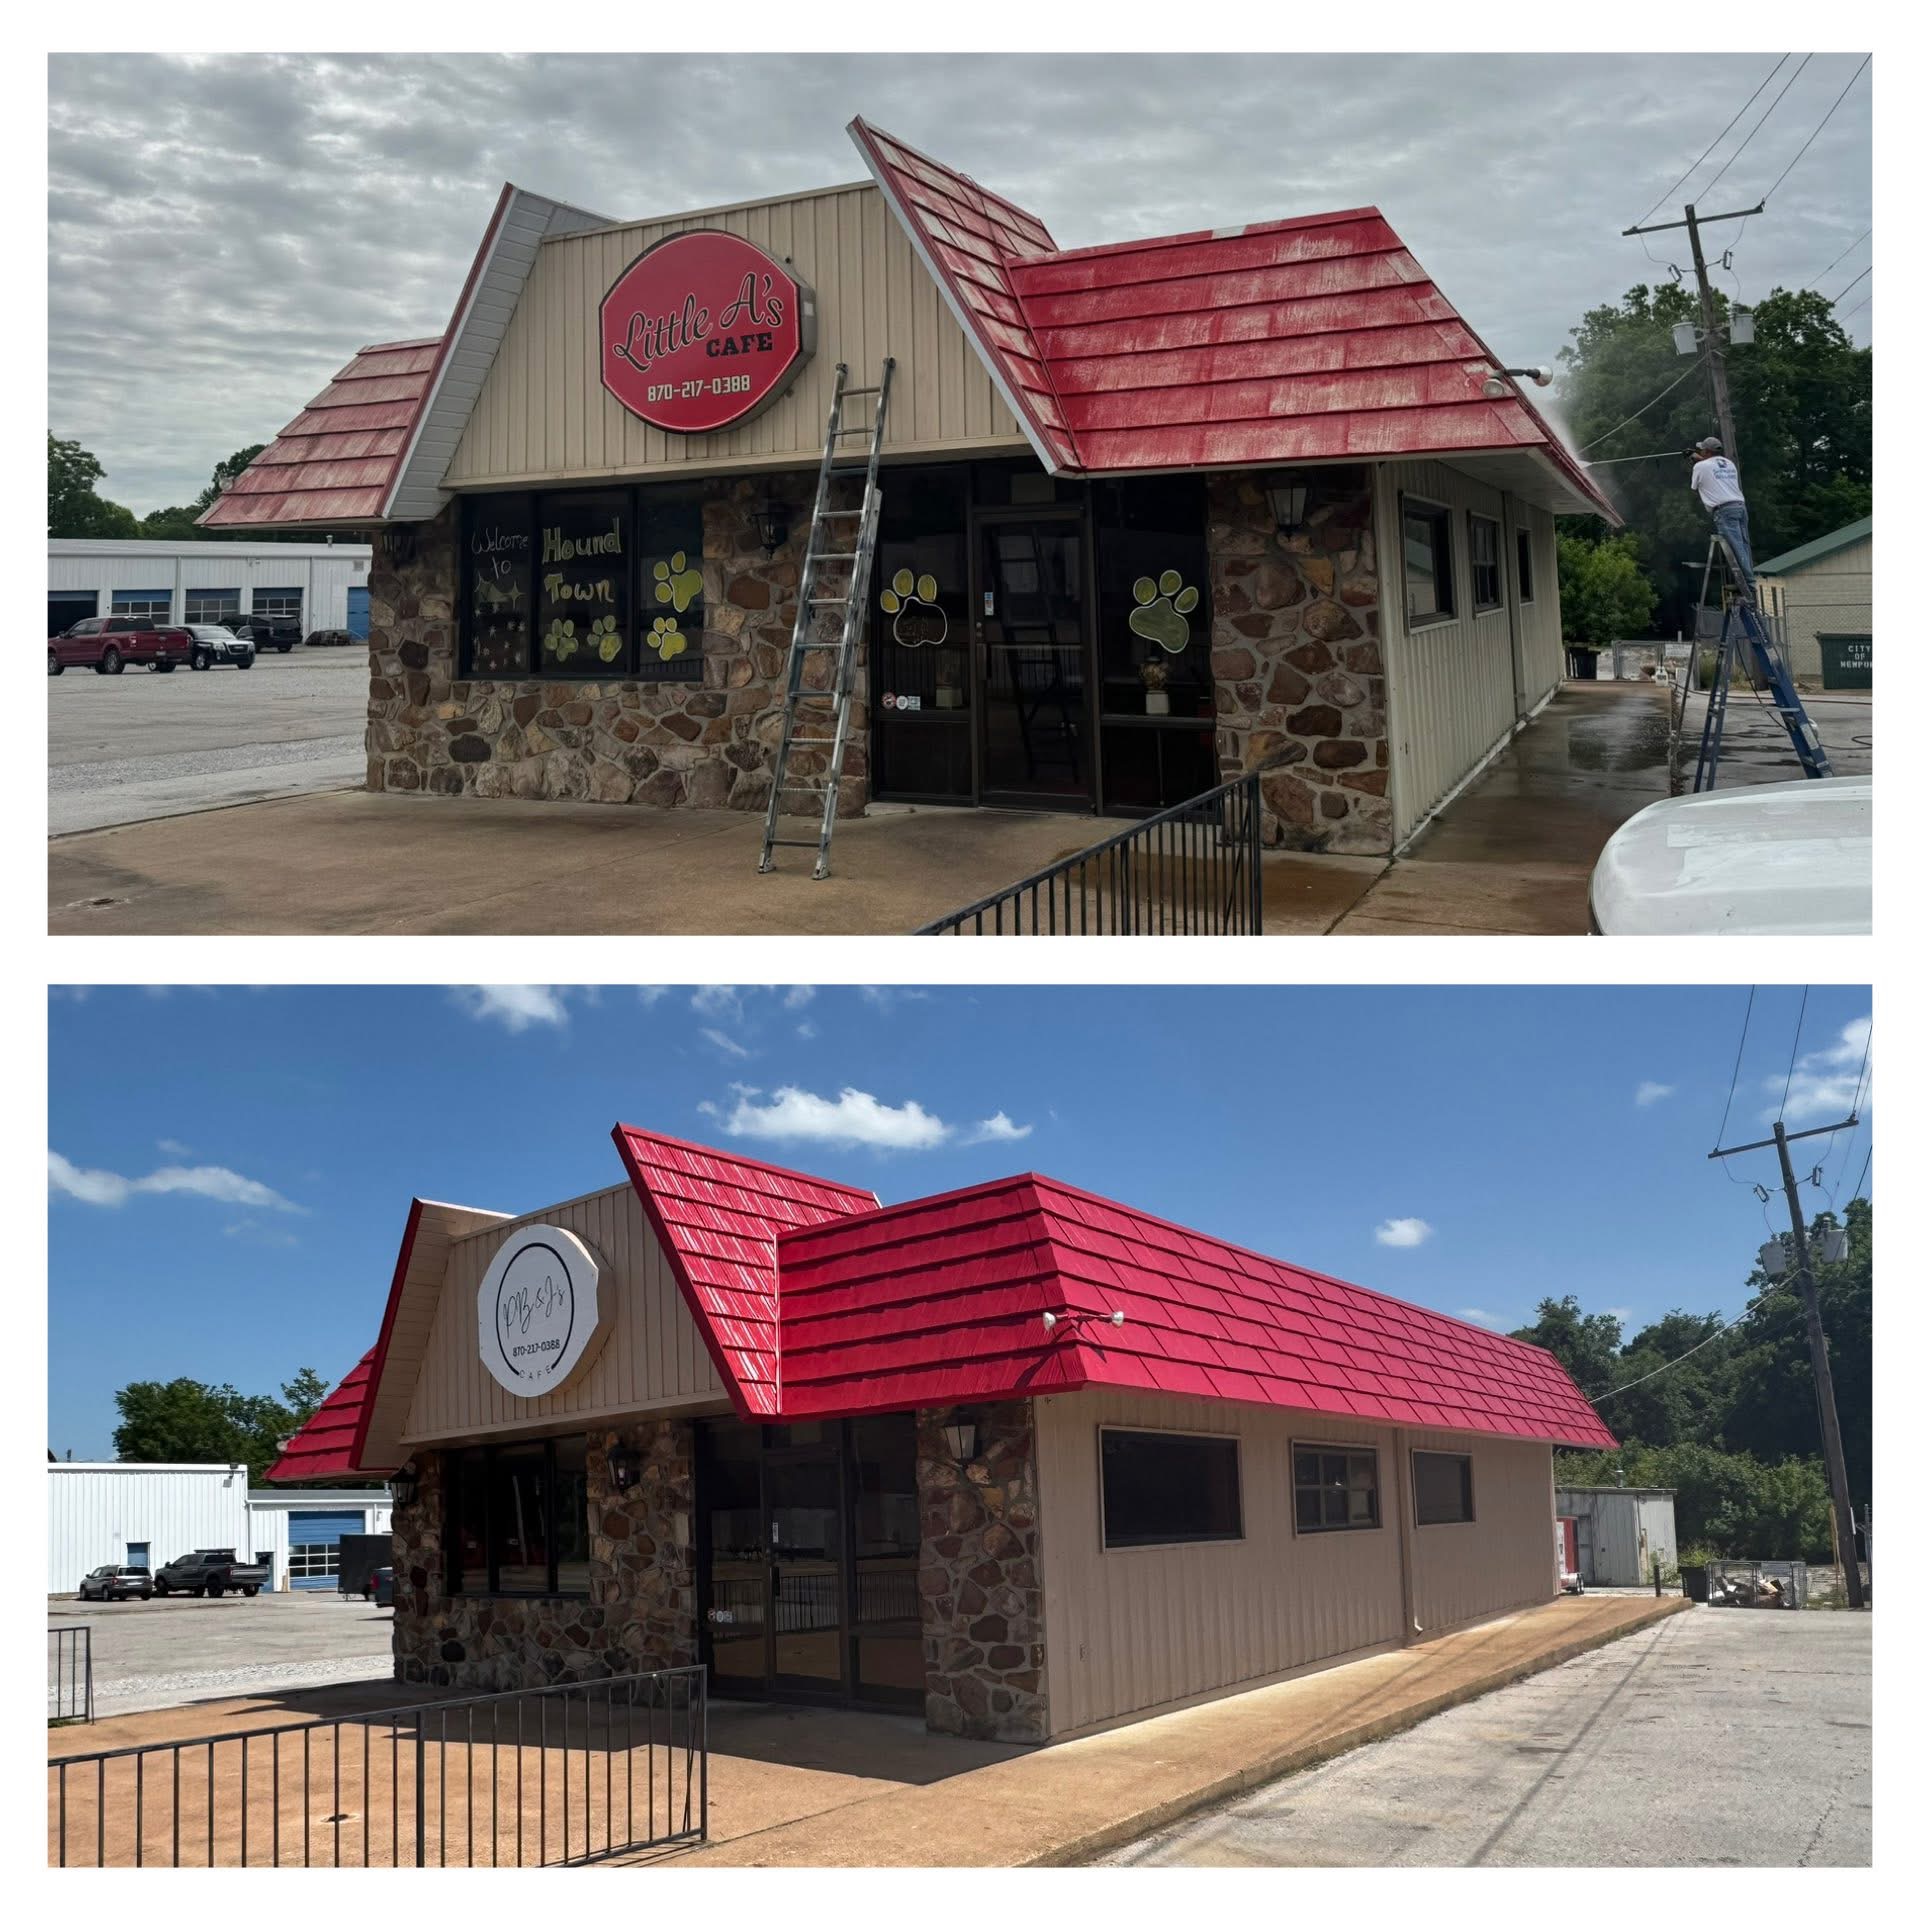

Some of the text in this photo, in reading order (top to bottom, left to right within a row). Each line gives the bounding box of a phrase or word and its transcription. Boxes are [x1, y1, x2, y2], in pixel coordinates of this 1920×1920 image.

[613, 271, 783, 372] Little A's
[706, 332, 773, 357] CAFE
[647, 374, 751, 402] 870-217-0388
[471, 525, 529, 554] Welcome
[542, 516, 621, 564] Hound
[544, 572, 615, 604] Town
[1847, 645, 1871, 653] CITY
[1854, 652, 1865, 660] OF
[512, 1339, 560, 1357] 870-217-0388
[519, 1365, 552, 1380] CAFE
